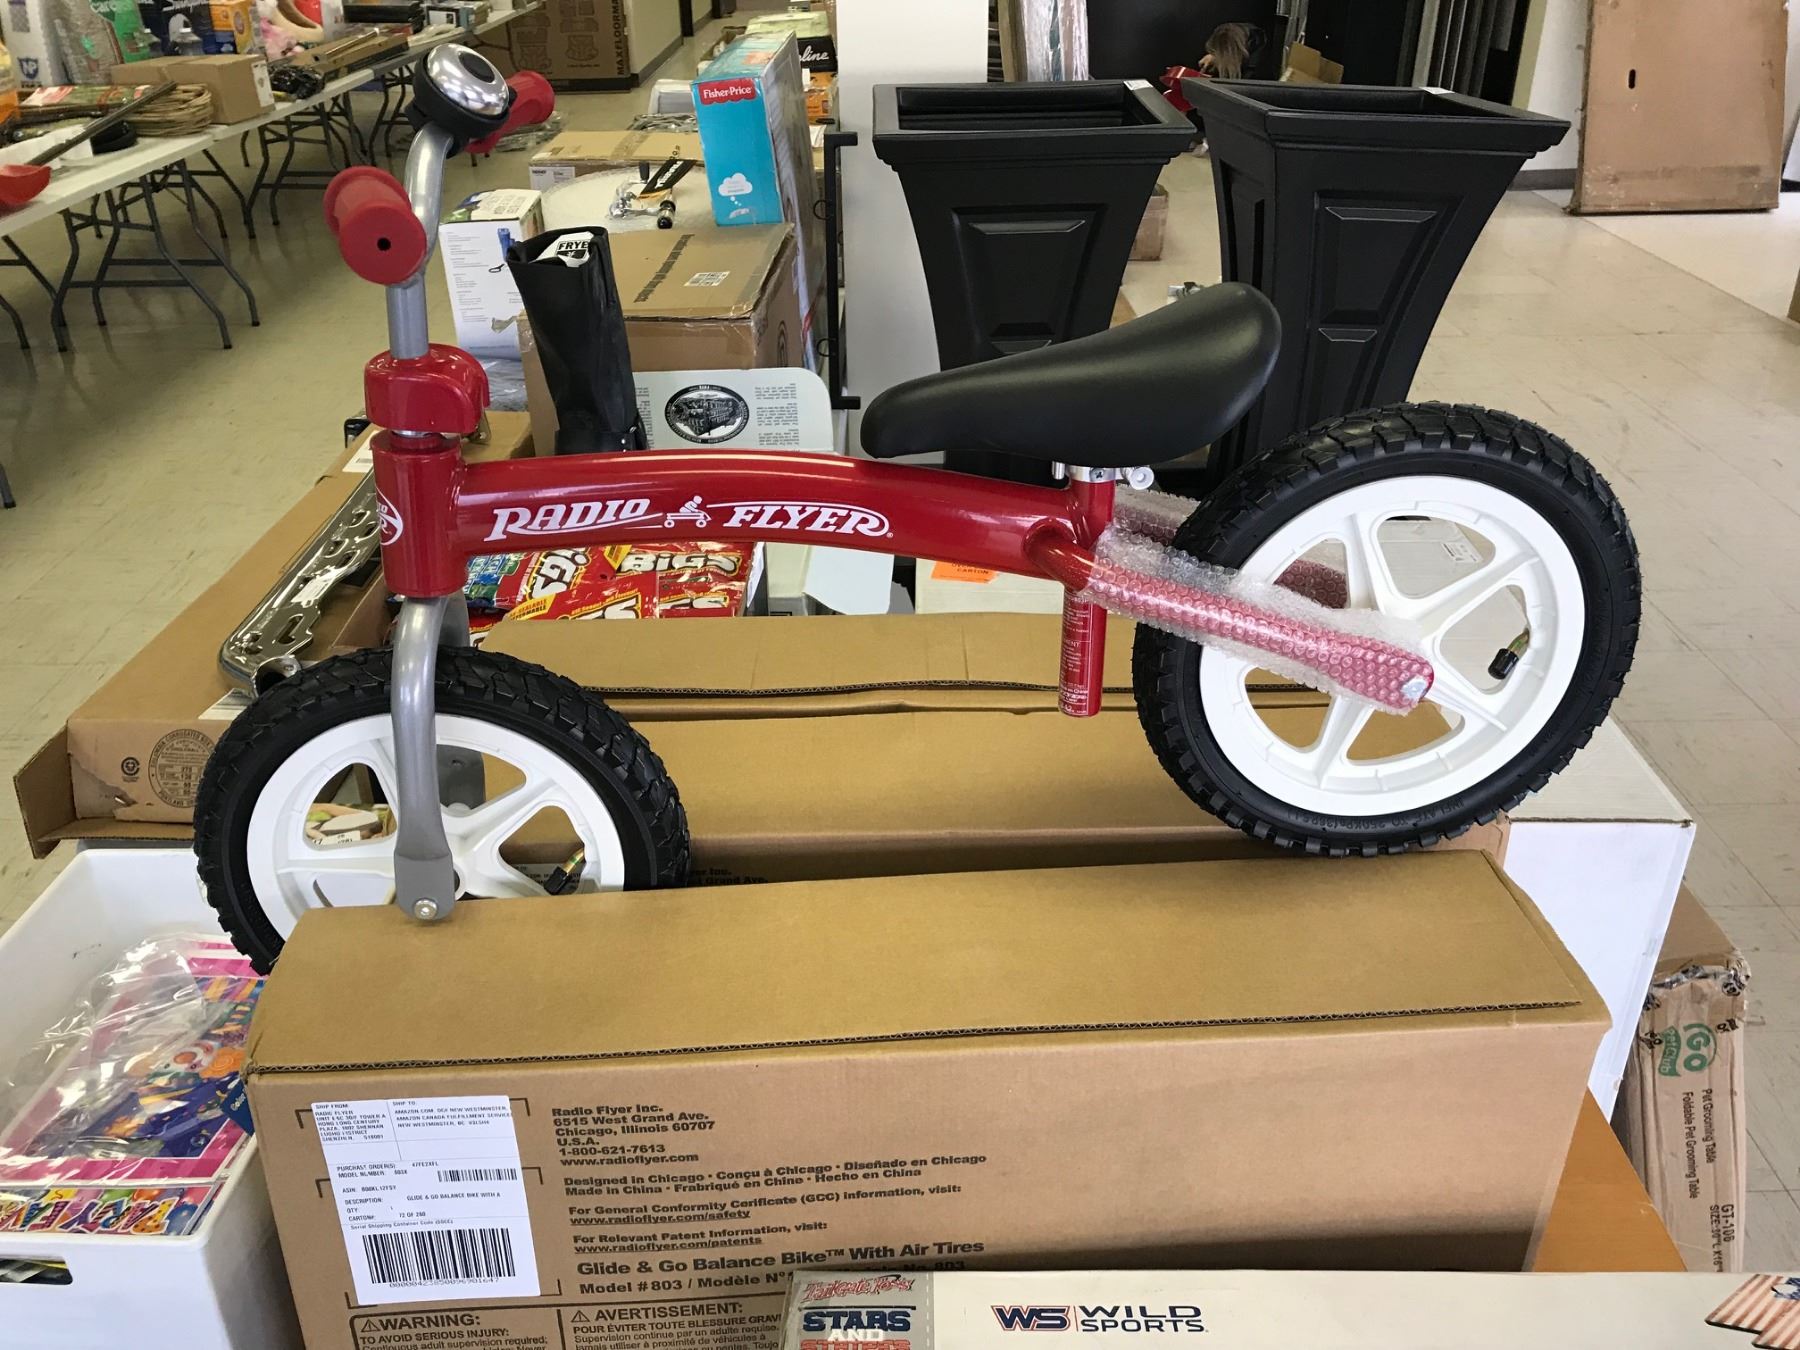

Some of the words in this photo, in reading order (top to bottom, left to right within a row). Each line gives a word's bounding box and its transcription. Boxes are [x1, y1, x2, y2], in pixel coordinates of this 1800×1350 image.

[703, 86, 752, 99] Fisher-Price
[558, 240, 588, 250] FRYE
[484, 498, 653, 542] RADIO
[722, 501, 892, 537] FLYER
[1702, 1088, 1713, 1102] Pet
[552, 1108, 593, 1117] Radio
[596, 1105, 633, 1117] Flyer
[636, 1104, 664, 1113] Inc.
[1682, 1092, 1694, 1124] Foldable
[553, 1117, 588, 1127] 6515
[592, 1115, 629, 1125] West
[631, 1113, 674, 1123] Grand
[678, 1111, 709, 1121] Ave.
[1702, 1104, 1715, 1142] Grooming
[555, 1126, 618, 1138] Chicago,
[622, 1123, 669, 1134] Illinois
[672, 1121, 716, 1132] 60707
[1685, 1126, 1696, 1140] Pet
[557, 1137, 600, 1146] U.S.A.
[559, 1144, 666, 1157] 1-800-621-7613
[561, 1153, 699, 1166] www.radioflyer.com
[1685, 1140, 1698, 1179] Grooming
[1704, 1143, 1716, 1164] Table
[564, 1176, 628, 1187] Designed
[631, 1175, 645, 1184] in
[648, 1173, 705, 1185] Chicago
[716, 1169, 760, 1180] Conçu
[764, 1168, 773, 1177] à
[775, 1165, 832, 1175] Chicago
[844, 1159, 907, 1171] Diseñado
[911, 1158, 927, 1166] en
[931, 1154, 987, 1166] Chicago
[565, 1187, 603, 1196] Made
[606, 1186, 619, 1195] in
[623, 1185, 662, 1195] China
[744, 1180, 760, 1188] en
[764, 1177, 804, 1186] Chine
[815, 1171, 858, 1183] Hecho
[862, 1171, 879, 1179] en
[883, 1168, 921, 1178] China
[1688, 1179, 1700, 1199] Table
[569, 1206, 591, 1215] For
[594, 1205, 647, 1215] General
[652, 1202, 726, 1214] Conformity
[801, 1193, 840, 1205] (GCC)
[843, 1187, 925, 1200] information,
[928, 1185, 961, 1195] visit:
[58, 1198, 178, 1235] PARTY
[570, 1210, 750, 1226] www.radioflyer.com/safety
[573, 1235, 595, 1243] For
[598, 1233, 657, 1243] Relevant
[661, 1231, 705, 1241] Patent
[709, 1225, 791, 1238] Information,
[795, 1222, 827, 1231] visit:
[574, 1236, 762, 1254] www.radioflyer.com/patents
[577, 1261, 631, 1275] Glide
[636, 1261, 652, 1273] &
[658, 1260, 688, 1272] Go
[693, 1255, 776, 1271] Balance
[849, 1245, 896, 1260] With
[900, 1243, 927, 1256] Air
[932, 1241, 985, 1254] Tires
[579, 1282, 632, 1294] Model
[697, 1274, 761, 1288] Modèle
[594, 1302, 743, 1321] AVERTISSEMENT:
[992, 1305, 1070, 1331] WS
[1079, 1305, 1201, 1318] WILD
[378, 1313, 480, 1331] WARNING:
[573, 1325, 605, 1334] POUR
[607, 1323, 646, 1333] ÉVITER
[648, 1320, 686, 1330] TOUTE
[688, 1317, 746, 1328] BLESSURE
[803, 1311, 911, 1331] STARS
[1081, 1319, 1206, 1332] SPORTS
[361, 1336, 376, 1345] TO
[378, 1333, 413, 1343] AVOID
[415, 1329, 464, 1341] SERIOUS
[467, 1328, 509, 1338] INJURY:
[574, 1333, 631, 1344] Supervision
[633, 1331, 674, 1341] continue
[677, 1330, 692, 1338] par
[710, 1327, 740, 1336] adulte
[741, 1324, 780, 1334] requise.
[610, 1341, 641, 1350] utiliser
[643, 1340, 650, 1348] à
[652, 1338, 695, 1349] proximité
[698, 1337, 710, 1345] de
[712, 1334, 757, 1344] véhicules
[760, 1333, 766, 1341] à
[828, 1328, 884, 1341] AND
[421, 1341, 445, 1350] adult
[447, 1338, 502, 1349] supervision
